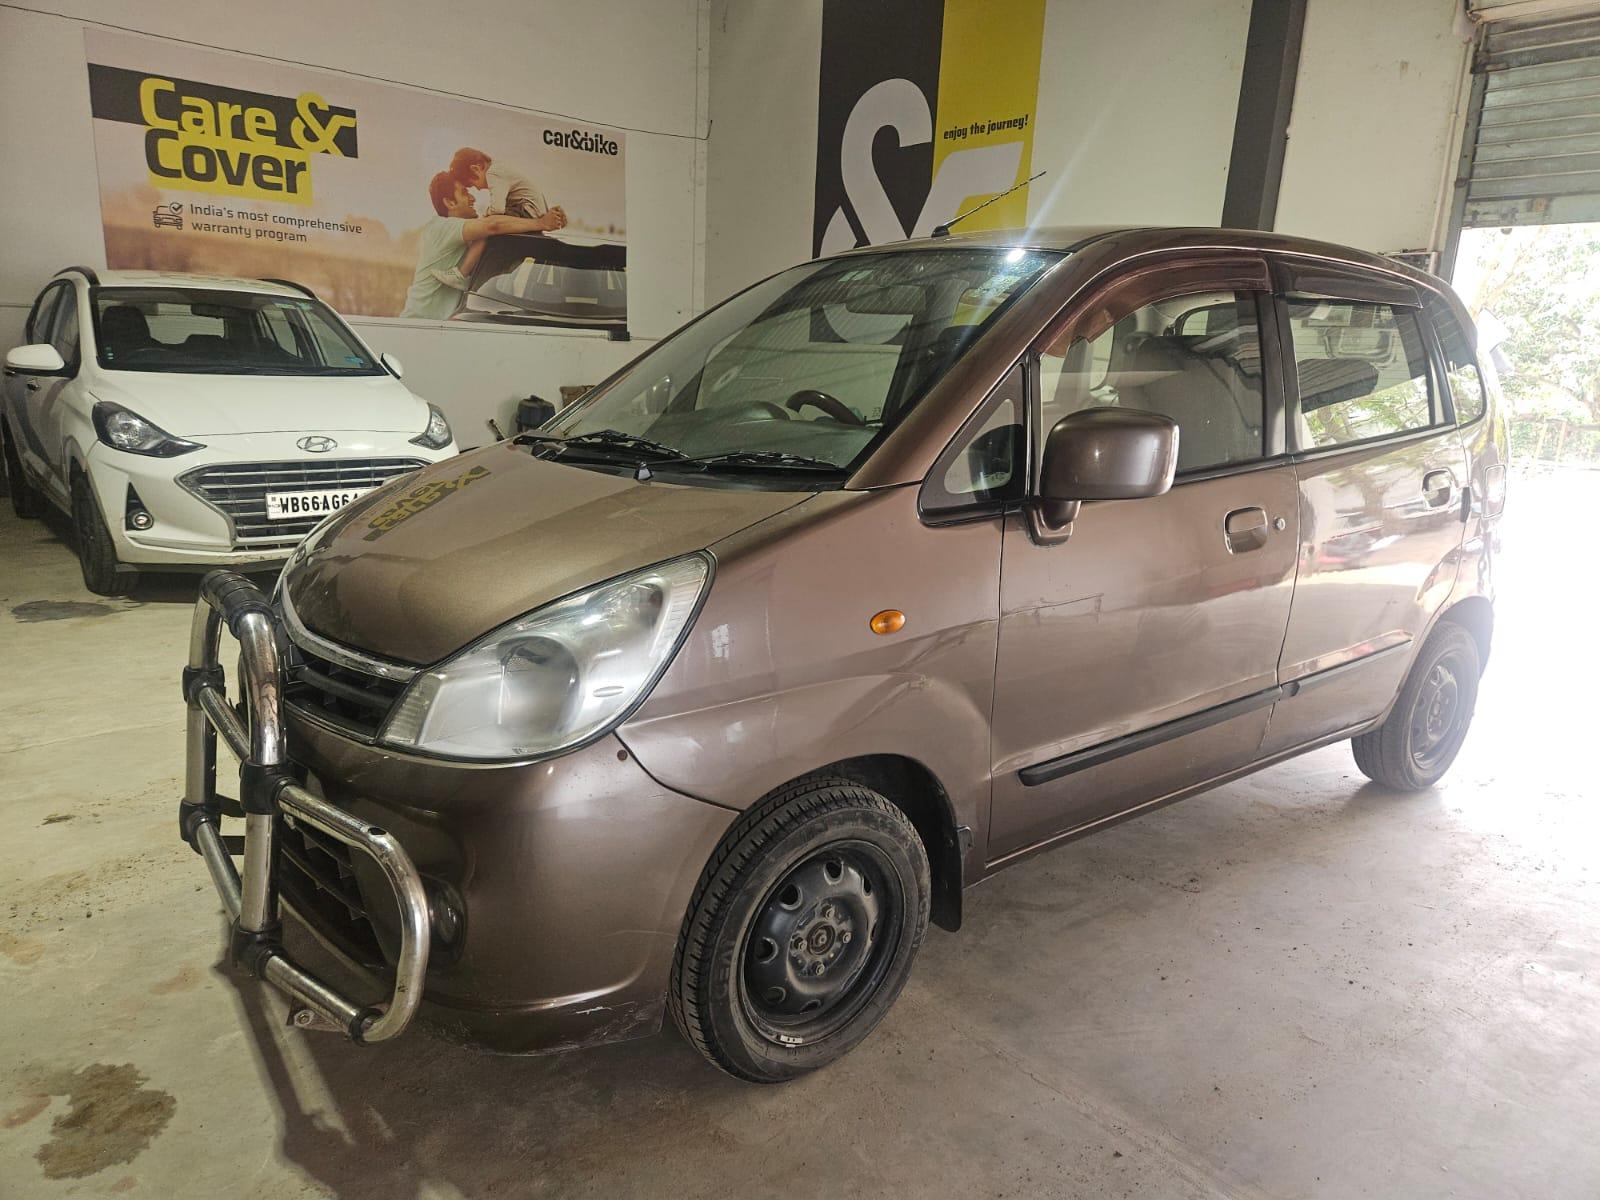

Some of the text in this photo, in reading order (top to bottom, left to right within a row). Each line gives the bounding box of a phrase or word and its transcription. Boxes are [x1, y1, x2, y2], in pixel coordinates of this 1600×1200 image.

[140, 78, 357, 157] Care &
[943, 114, 1028, 141] enjoy the journey!
[542, 129, 618, 156] car&bike
[145, 127, 307, 194] Cover
[190, 203, 363, 234] India's most comprehensive
[191, 221, 307, 243] warranty program
